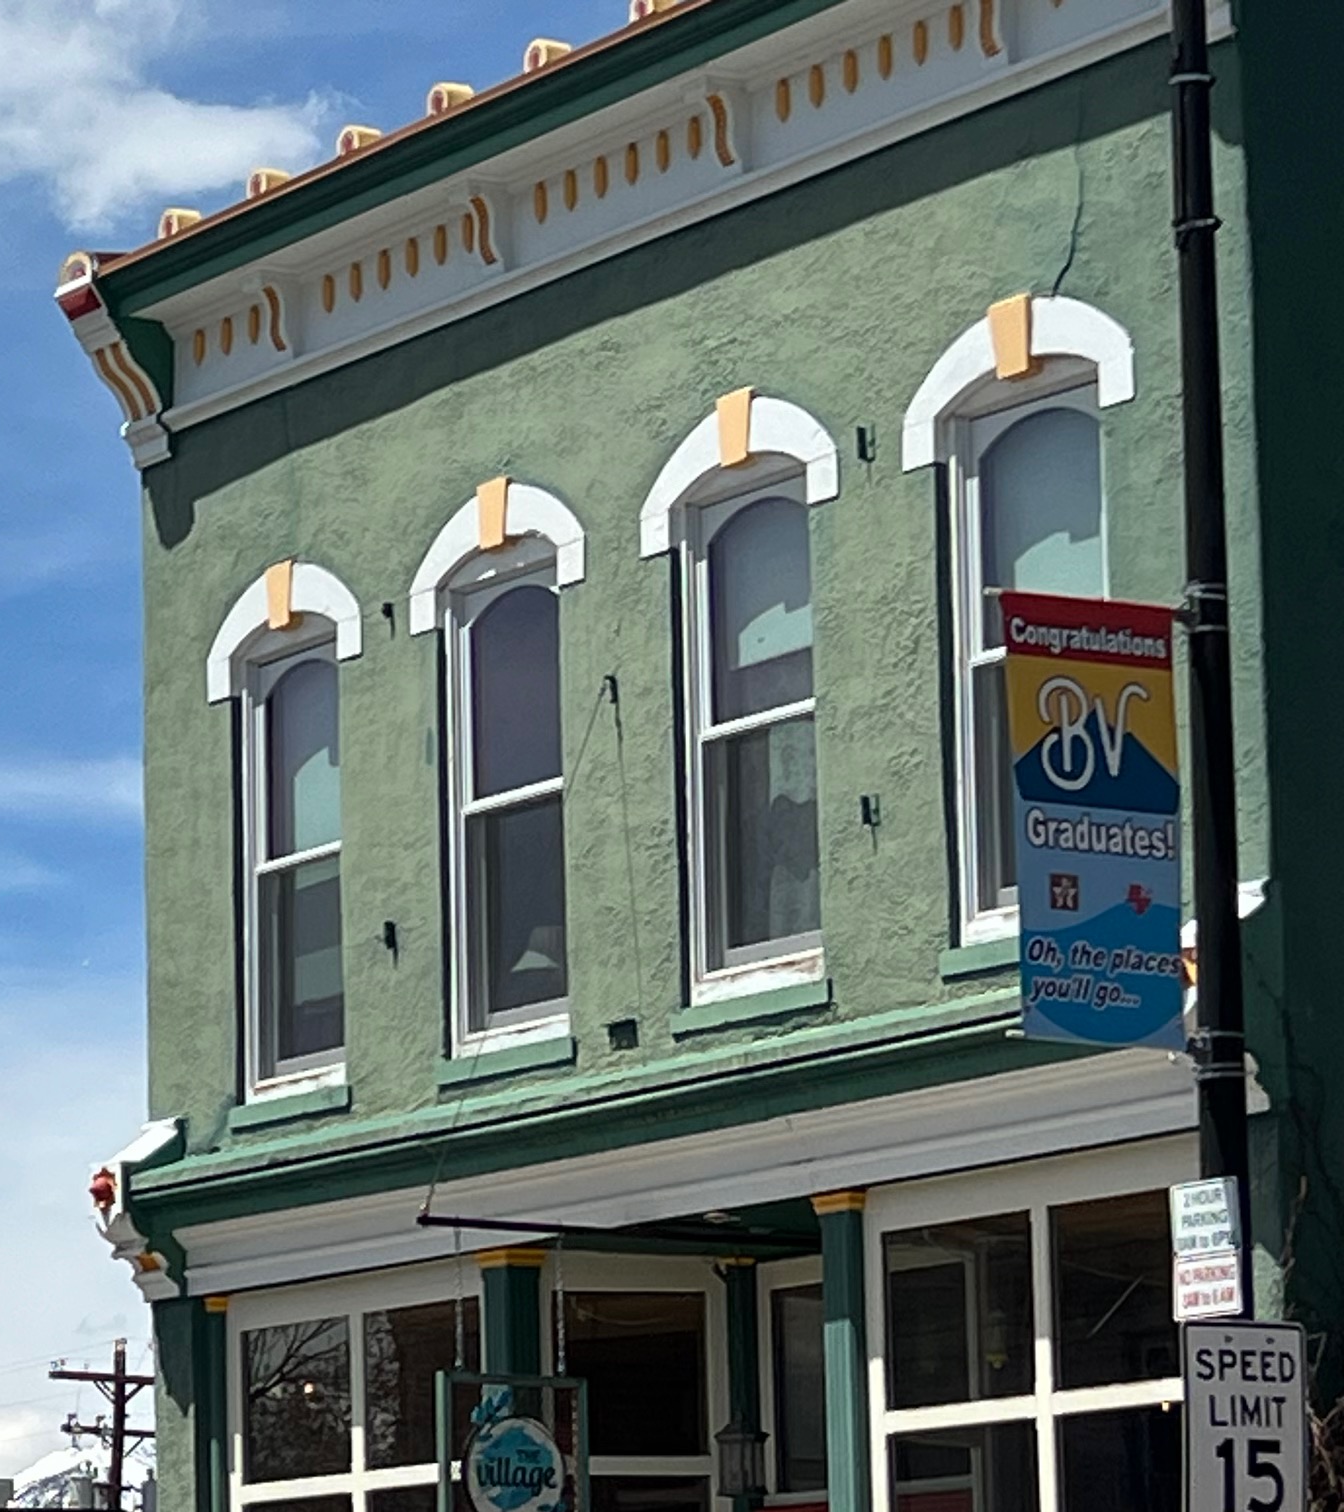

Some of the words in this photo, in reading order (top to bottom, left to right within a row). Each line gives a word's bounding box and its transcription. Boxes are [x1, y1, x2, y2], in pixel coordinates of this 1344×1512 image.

[1010, 616, 1168, 658] Congratulations
[1038, 675, 1149, 791] BV
[1026, 808, 1175, 859] Graduates!
[1027, 937, 1063, 970] Oh,
[1070, 943, 1106, 969] the
[1109, 948, 1181, 976] places
[1029, 974, 1091, 1002] you'll
[1192, 1187, 1223, 1205] HOUR
[1182, 1209, 1229, 1229] PARKING
[1179, 1269, 1191, 1286] NO
[1193, 1263, 1235, 1283] PARKING
[1195, 1348, 1297, 1383] SPEED
[1208, 1394, 1287, 1428] LIMIT
[476, 1456, 558, 1497] village
